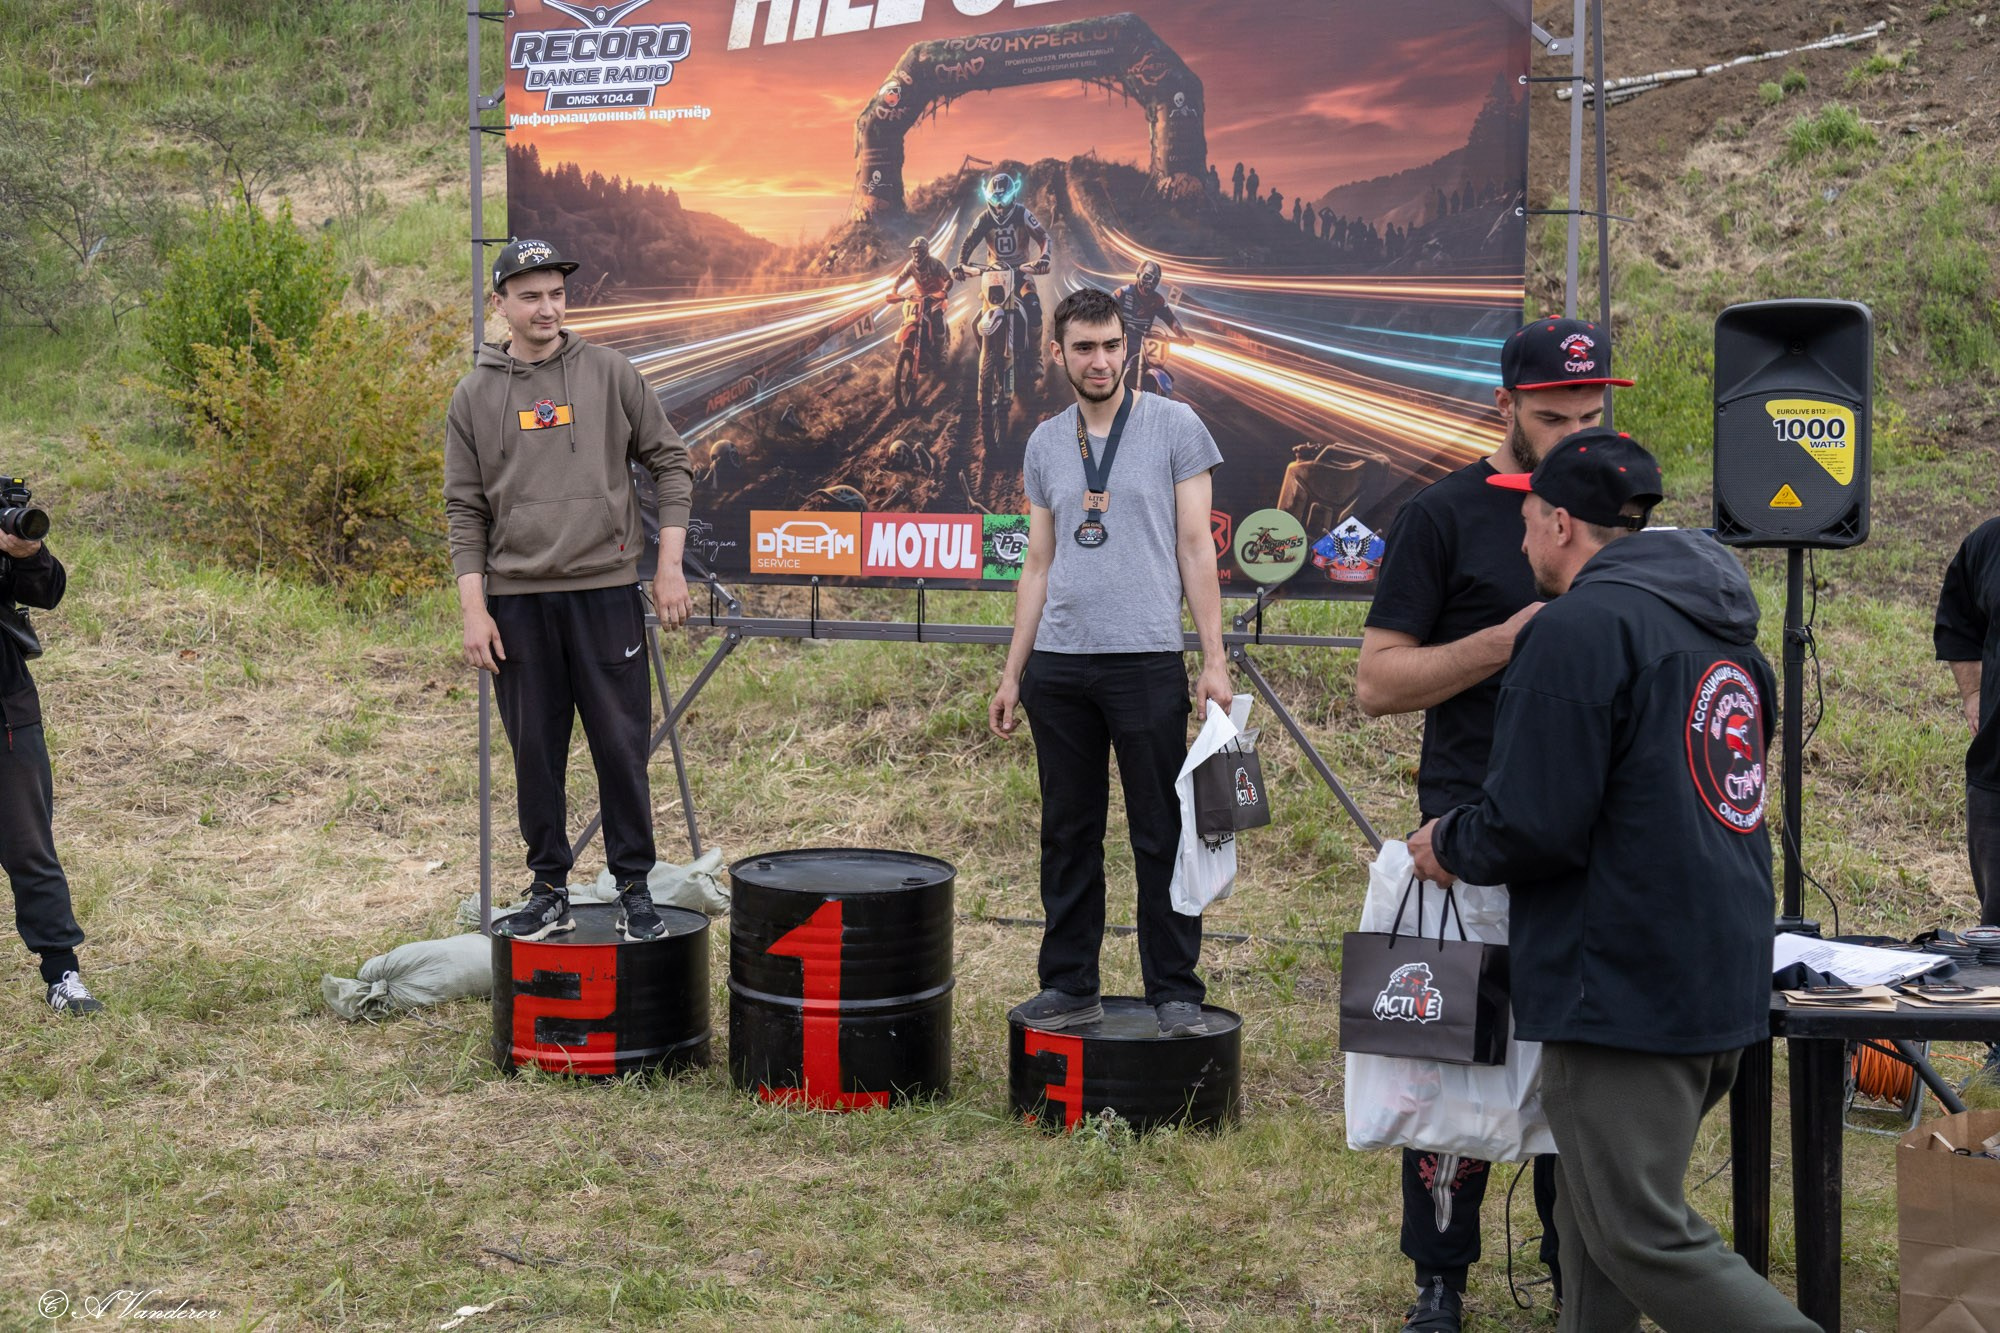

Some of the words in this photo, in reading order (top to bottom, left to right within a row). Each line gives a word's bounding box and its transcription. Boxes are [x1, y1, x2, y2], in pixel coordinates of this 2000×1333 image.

[512, 27, 690, 65] RECORD
[530, 68, 601, 88] DANCE
[605, 63, 671, 83] RADIO
[566, 94, 599, 105] OMSK
[602, 93, 634, 104] 104.4
[510, 107, 646, 127] Информационный
[649, 106, 711, 120] партнёр
[517, 247, 552, 264] garage
[1773, 418, 1845, 441] 1000
[1810, 440, 1846, 449] WATTS
[757, 529, 854, 559] DREAM
[867, 522, 978, 569] MOTUL
[757, 558, 800, 568] SERVICE
[511, 940, 618, 1076] 2
[765, 899, 890, 1113] 1
[1376, 991, 1438, 1018] ACTIVE
